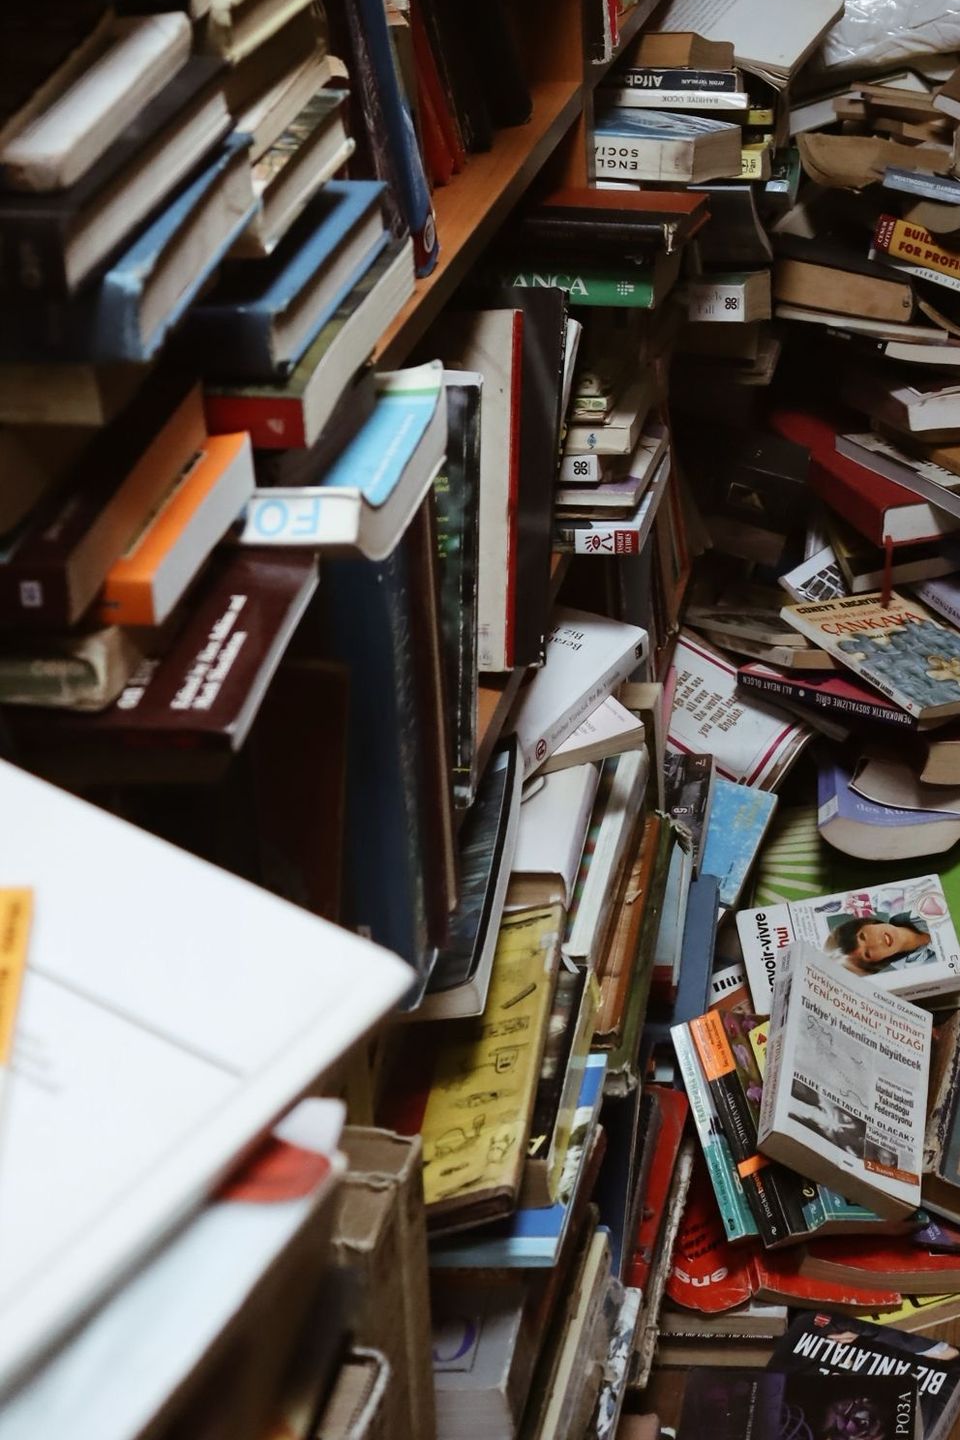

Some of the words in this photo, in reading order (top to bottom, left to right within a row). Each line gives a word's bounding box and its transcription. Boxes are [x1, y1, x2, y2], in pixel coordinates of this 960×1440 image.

[625, 75, 663, 87] Alfab
[597, 159, 638, 170] ENGL
[897, 241, 923, 257] FOR
[512, 275, 589, 296] ANCA
[253, 498, 321, 538] FO
[821, 612, 924, 636] ÇANKAYA
[719, 708, 745, 732] English
[804, 966, 859, 1006] Türkiye'nin
[858, 1001, 889, 1021] Siyasi
[800, 995, 840, 1028] Türkiye'yi
[876, 1043, 924, 1073] büyütecek
[882, 1025, 927, 1053] TUZAĞI
[871, 1102, 916, 1128] Federasyonu
[875, 1120, 917, 1144] OLACAK?
[750, 1172, 775, 1218] pocketbook
[792, 1331, 909, 1378] ANLATALIM
[895, 1390, 913, 1435] РОЗА
